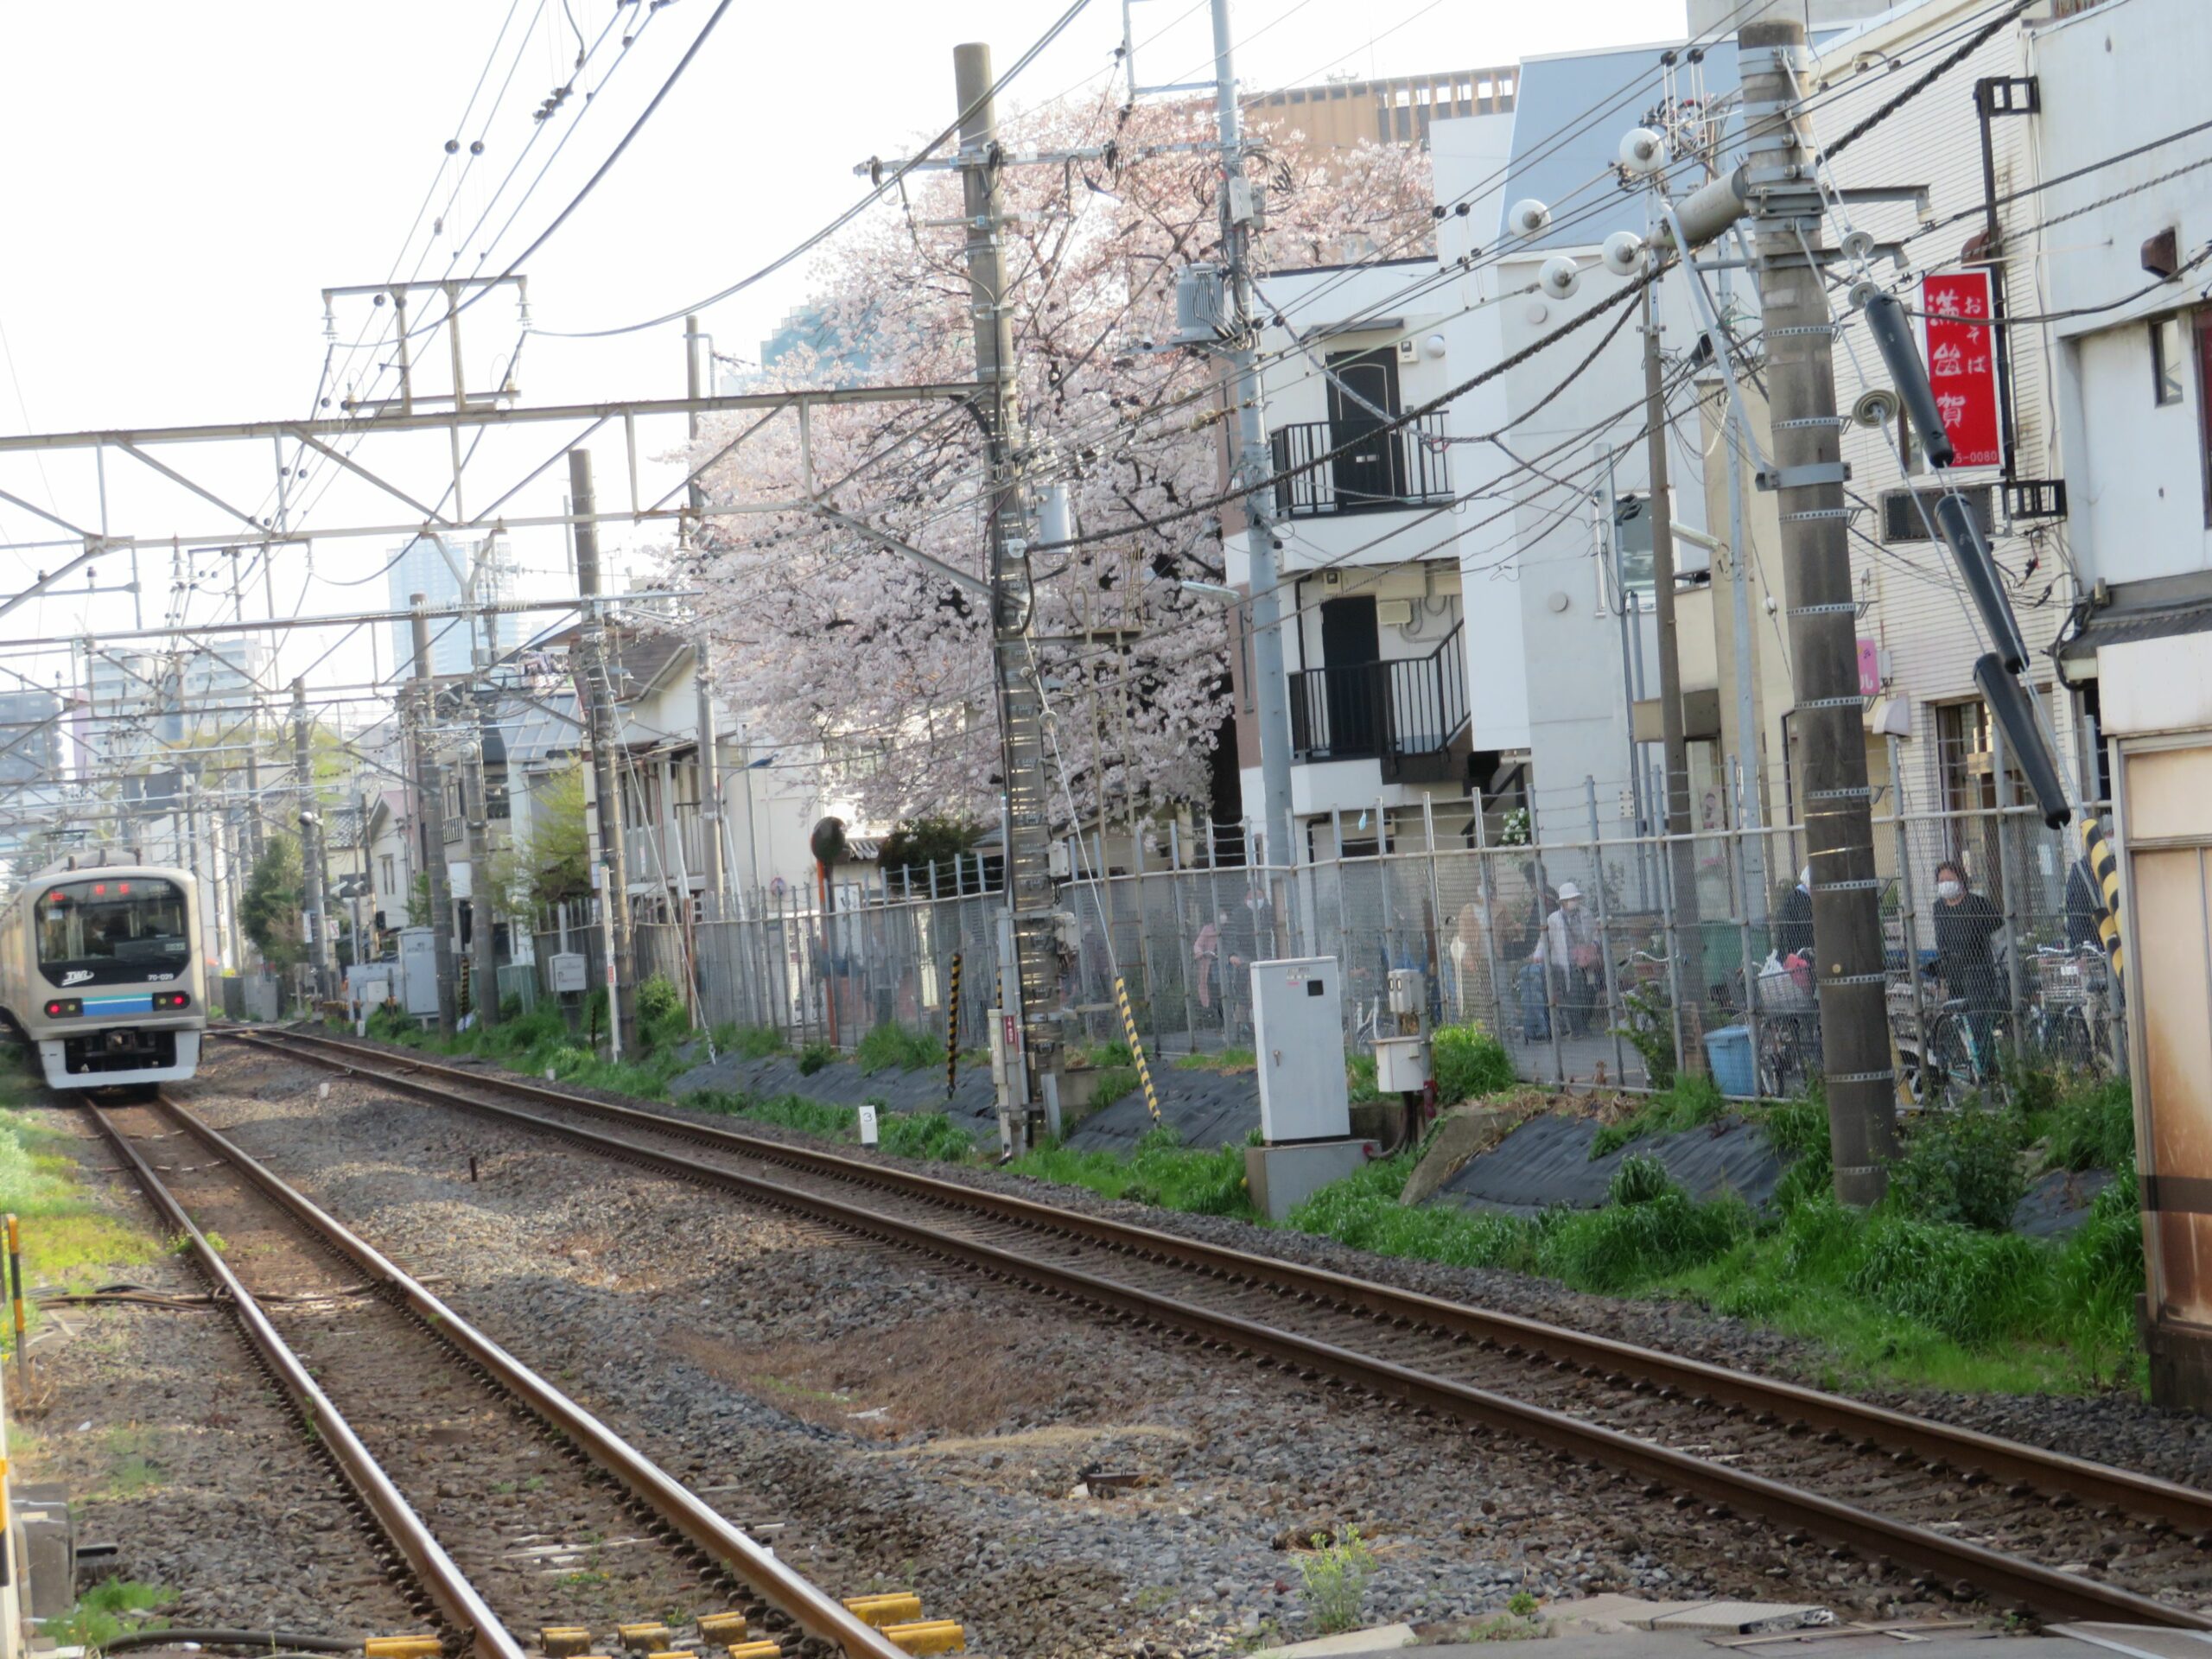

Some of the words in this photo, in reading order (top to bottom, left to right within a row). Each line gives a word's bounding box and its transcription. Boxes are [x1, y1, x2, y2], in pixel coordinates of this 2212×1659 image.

[1964, 296, 1986, 374] おそば
[863, 1112, 872, 1122] 3
